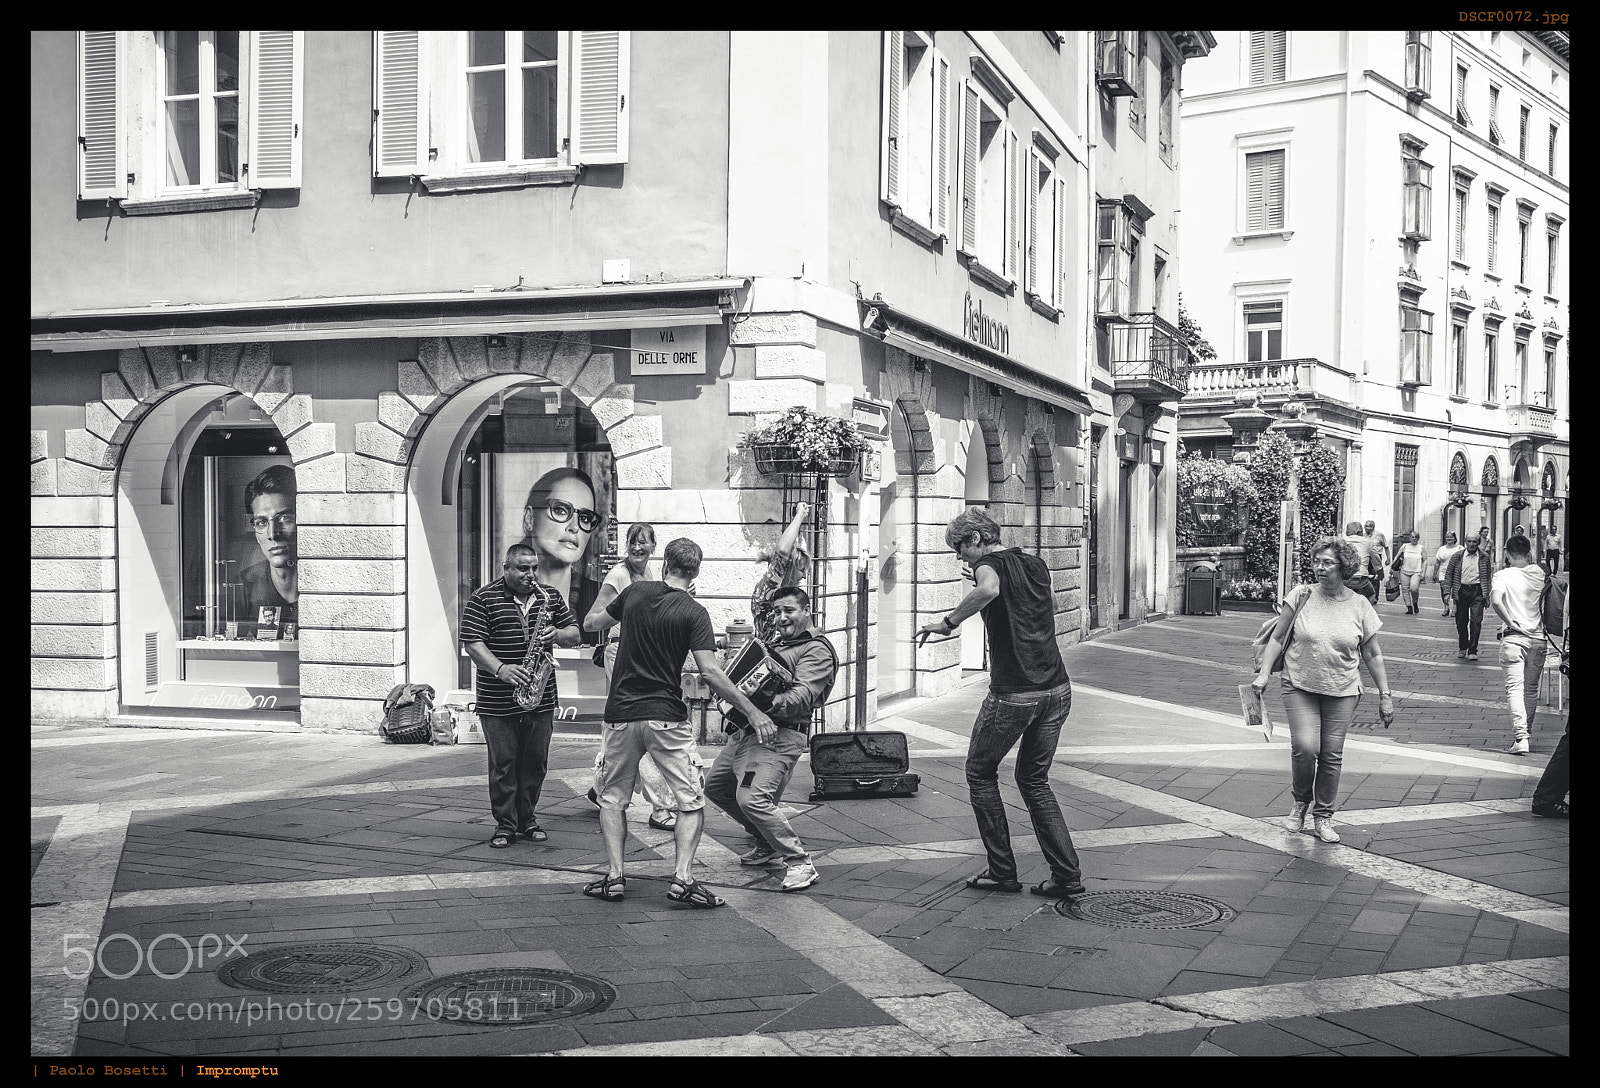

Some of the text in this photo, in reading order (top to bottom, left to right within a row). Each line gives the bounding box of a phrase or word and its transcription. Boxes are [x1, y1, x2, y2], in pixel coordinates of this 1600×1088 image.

[964, 290, 1009, 354] fielmann
[660, 330, 675, 343] VIA
[638, 351, 698, 365] DELLE ORNE
[190, 688, 277, 708] fielmann
